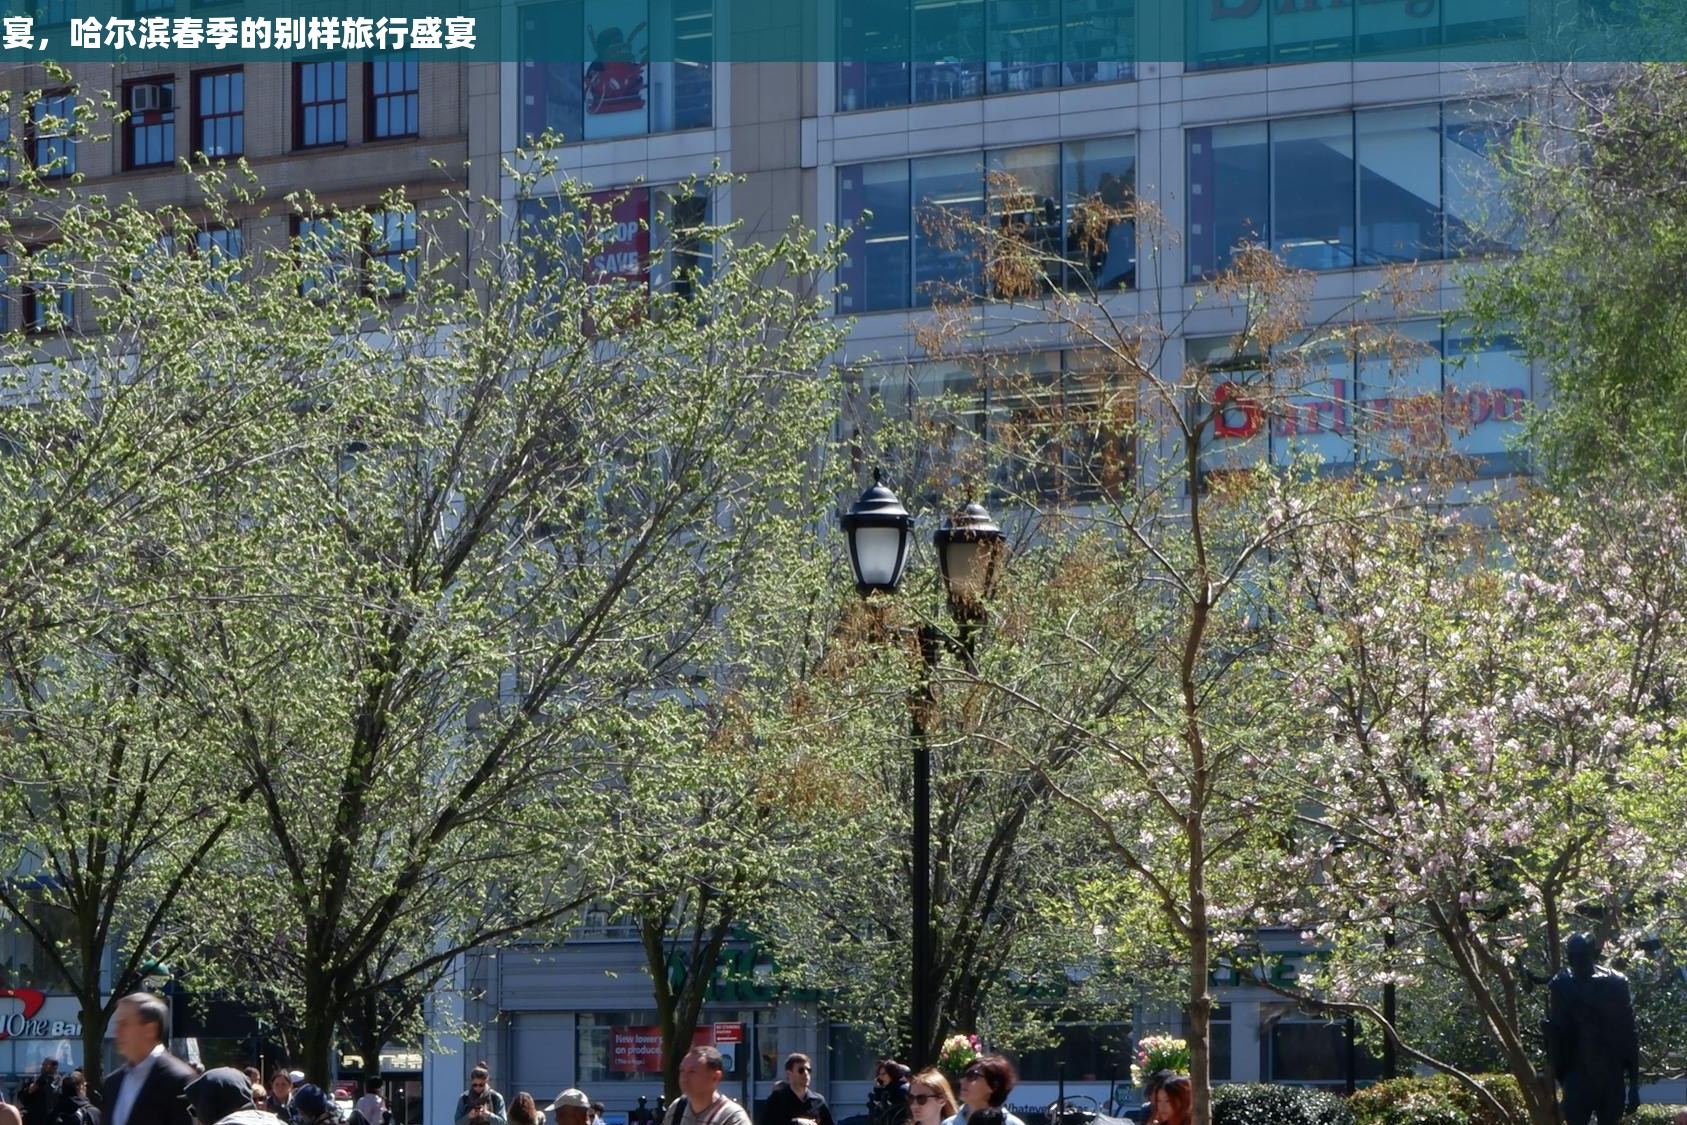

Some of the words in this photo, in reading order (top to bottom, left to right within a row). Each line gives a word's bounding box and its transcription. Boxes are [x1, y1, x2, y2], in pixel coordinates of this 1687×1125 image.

[616, 1034, 633, 1044] New
[635, 1034, 658, 1044] lower
[615, 1047, 626, 1055] on
